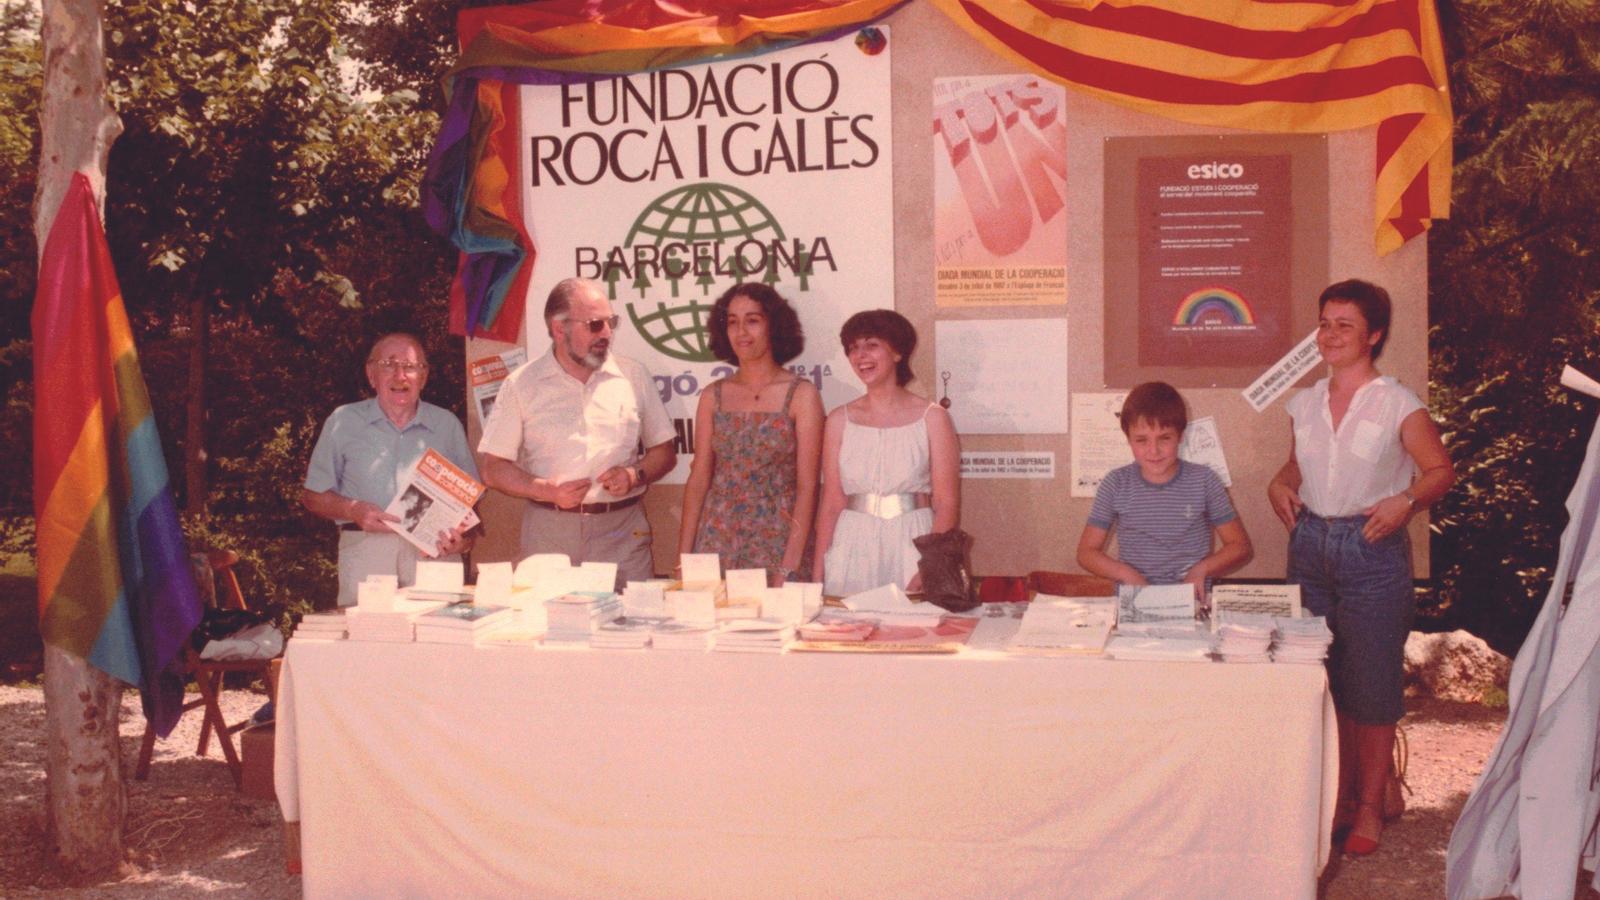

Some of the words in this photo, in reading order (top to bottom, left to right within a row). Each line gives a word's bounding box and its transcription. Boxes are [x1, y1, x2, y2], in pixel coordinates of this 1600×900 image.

[560, 53, 840, 128] FUNDACIÓ
[531, 125, 684, 187] ROCA
[696, 124, 709, 179] I
[721, 110, 880, 177] GALÈS
[1187, 160, 1244, 180] esico
[575, 236, 838, 281] BARCELONA
[960, 269, 993, 280] MUNDIAL
[994, 269, 1004, 279] DE
[1007, 269, 1017, 279] LA
